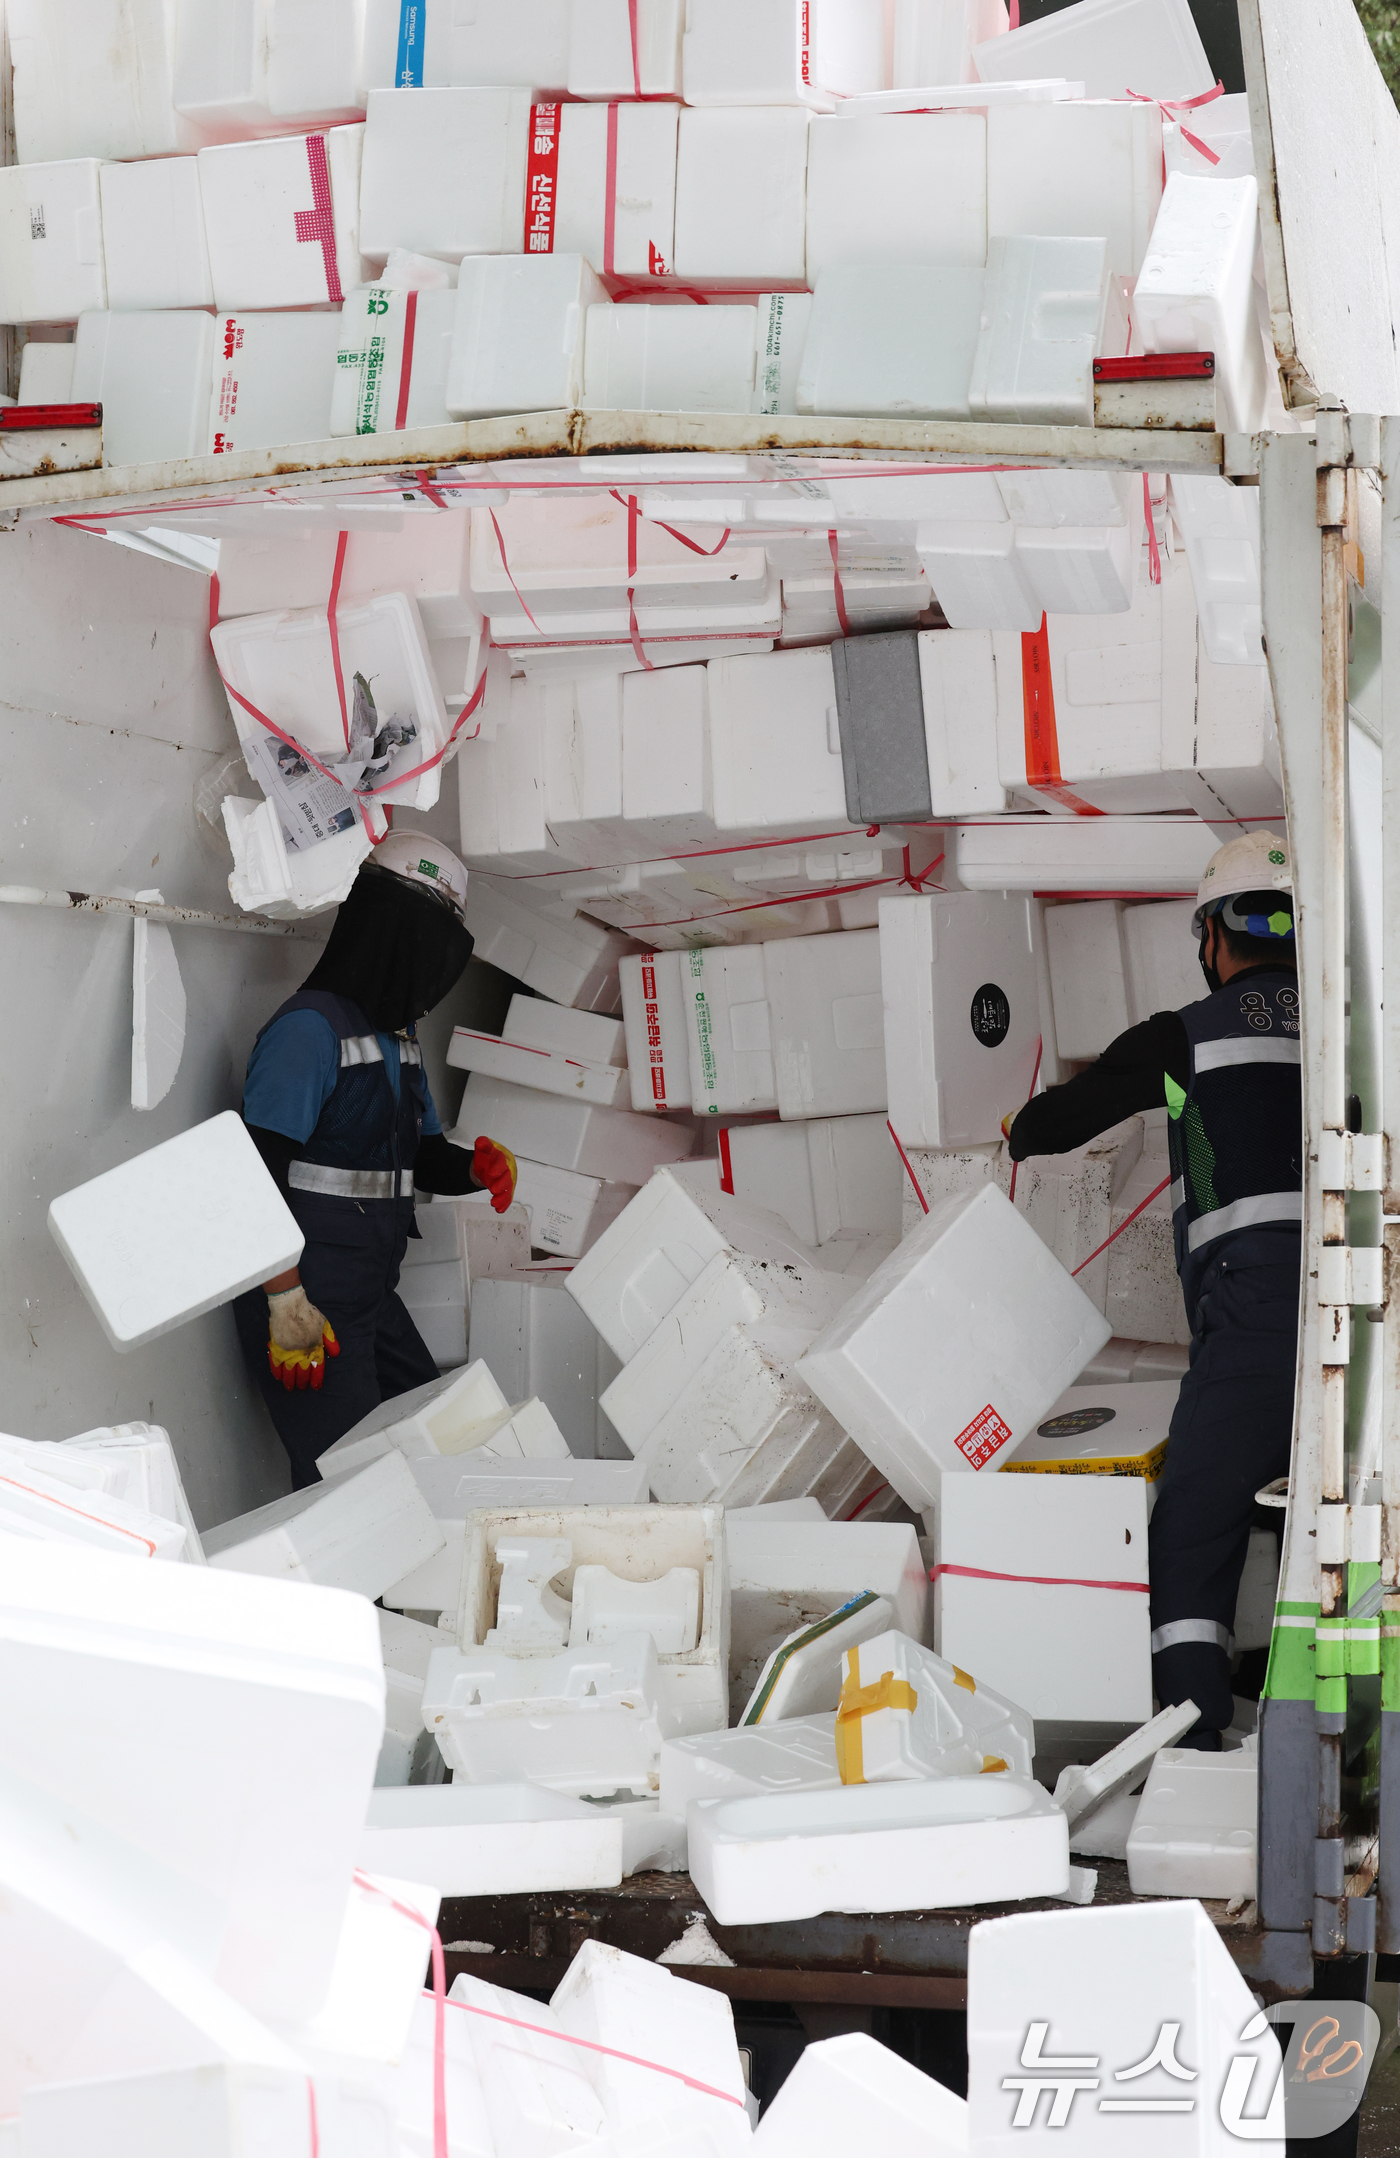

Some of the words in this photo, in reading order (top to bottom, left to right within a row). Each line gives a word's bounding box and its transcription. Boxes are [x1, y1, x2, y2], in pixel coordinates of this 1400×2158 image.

[408, 6, 418, 46] Samsung
[529, 173, 553, 252] 신선식품
[766, 295, 777, 356] 1004kimchi.com
[646, 1003, 661, 1047] 취급주의
[1281, 1018, 1300, 1032] YO
[968, 1425, 1011, 1468] 취급주의
